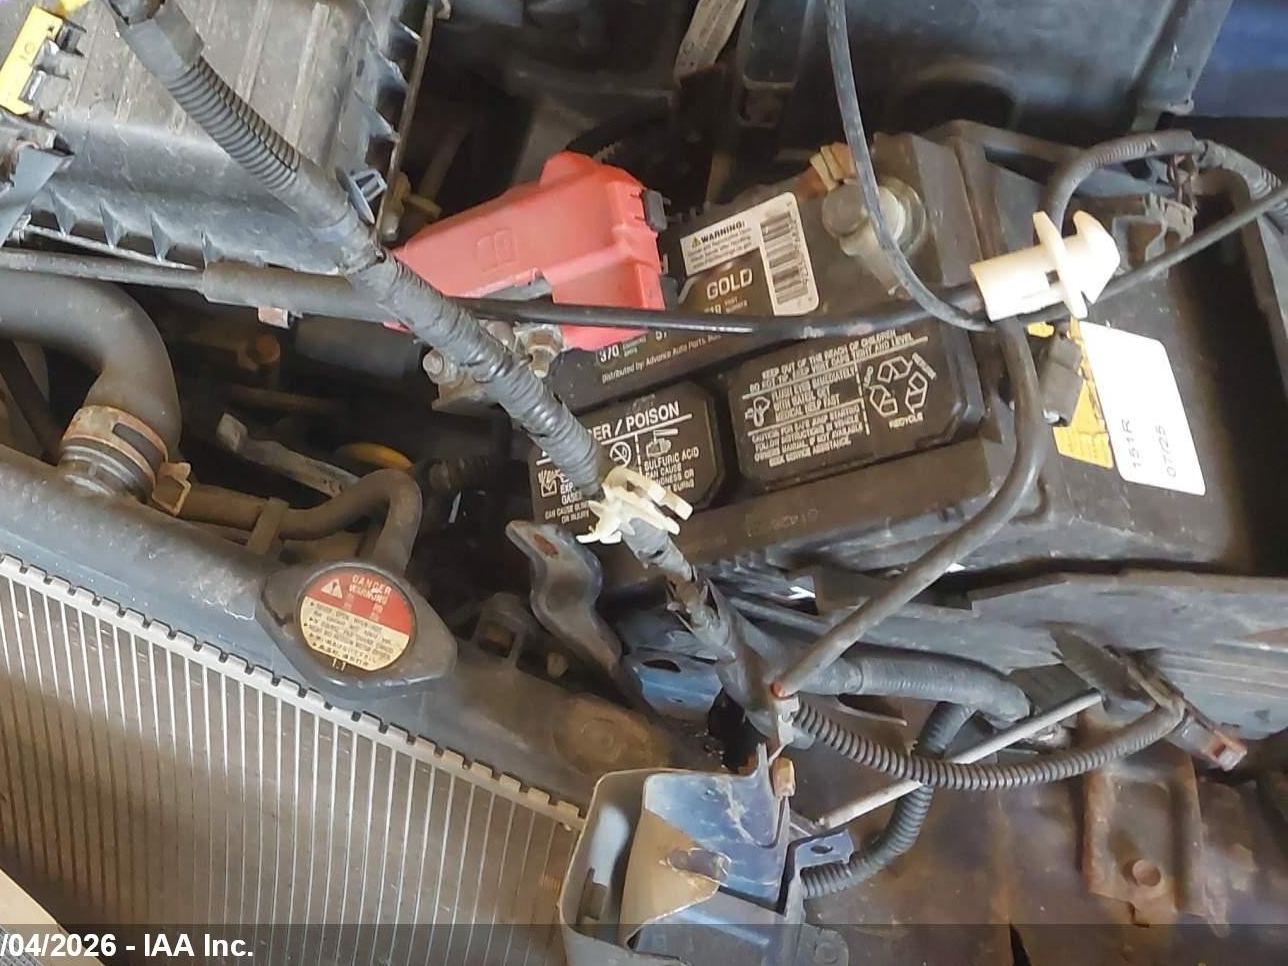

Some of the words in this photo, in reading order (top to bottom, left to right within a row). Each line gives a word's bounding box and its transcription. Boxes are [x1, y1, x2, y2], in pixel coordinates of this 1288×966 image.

[706, 268, 753, 301] GOLD
[646, 347, 672, 366] Advance
[672, 343, 688, 356] Auto
[762, 366, 780, 379] KEEP
[781, 361, 795, 374] OUT
[797, 358, 807, 370] OF
[808, 353, 824, 367] THE
[824, 346, 848, 363] REACH
[849, 341, 861, 355] OF
[861, 330, 897, 349] CHILDREN
[626, 401, 680, 431] POISON
[805, 400, 822, 414] HELP
[823, 394, 840, 408] FAST
[644, 451, 680, 471] SULFURIC
[681, 446, 700, 462] ACID
[352, 574, 392, 595] DANGER
